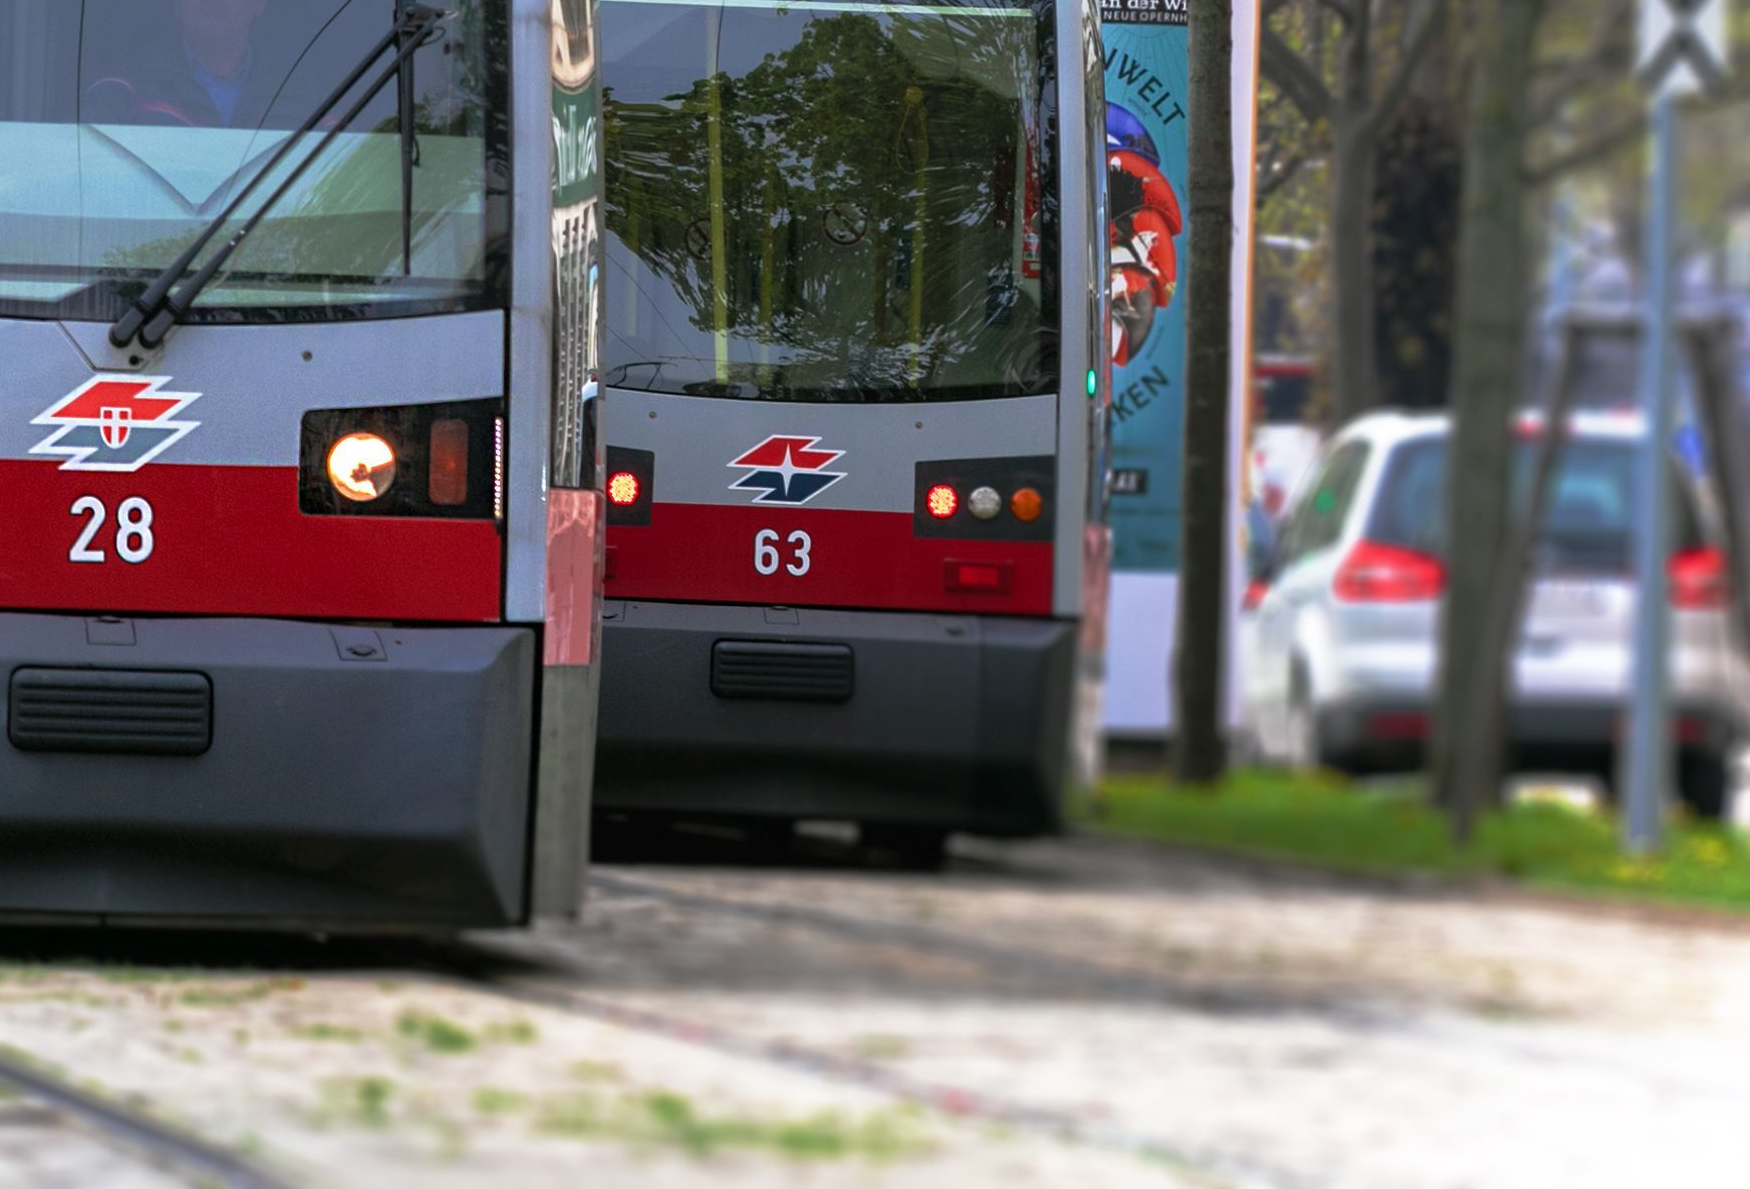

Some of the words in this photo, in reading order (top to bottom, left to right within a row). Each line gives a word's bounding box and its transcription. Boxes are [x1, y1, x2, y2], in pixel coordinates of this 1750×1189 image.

[1103, 11, 1138, 22] NEUE
[1110, 364, 1170, 427] KEN
[68, 494, 155, 564] 28
[754, 528, 812, 577] 63
